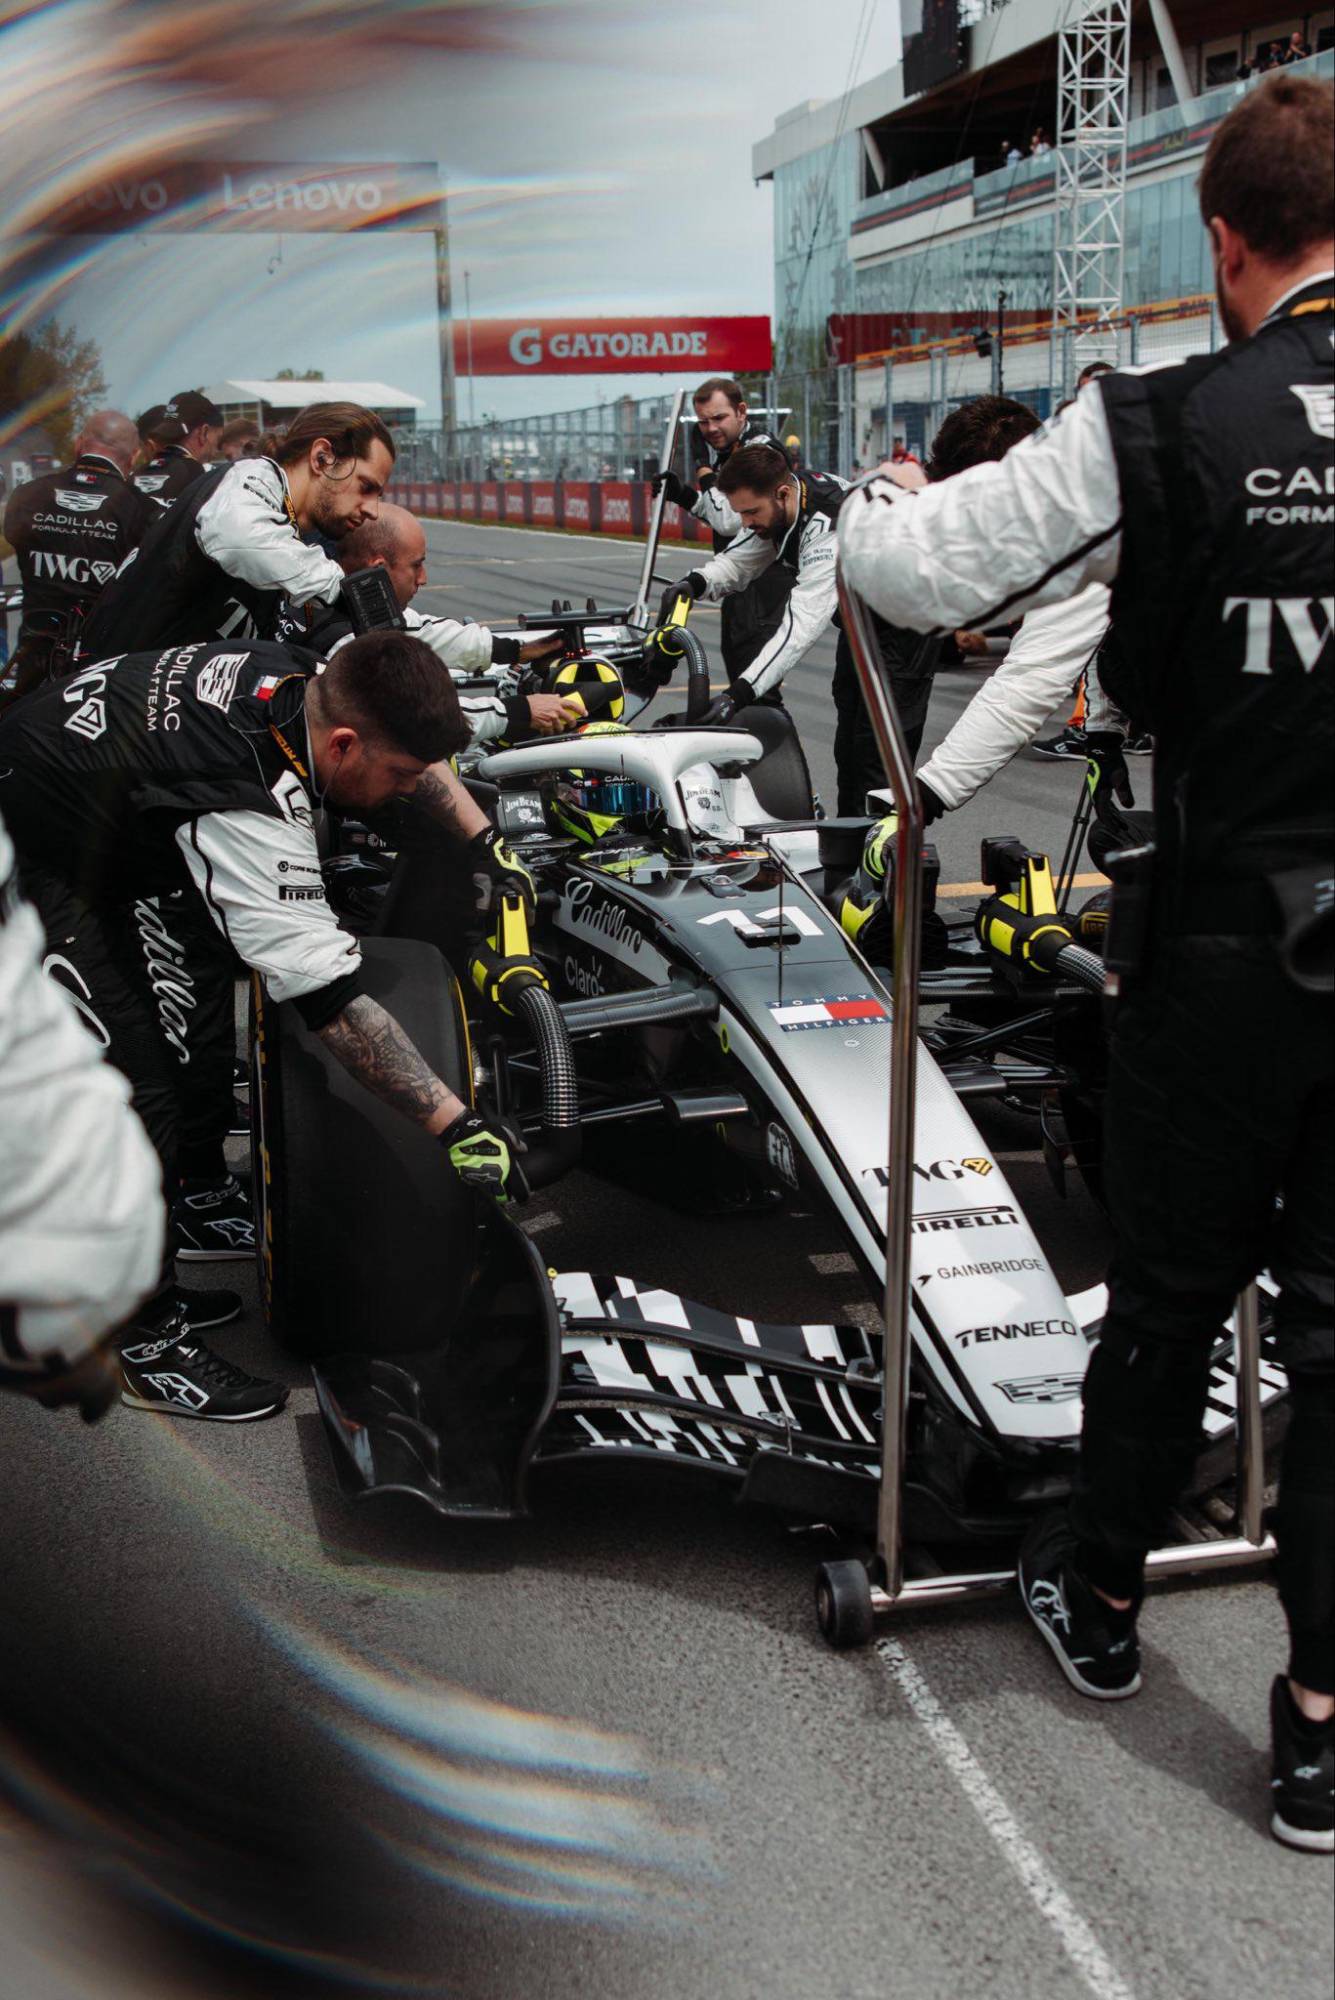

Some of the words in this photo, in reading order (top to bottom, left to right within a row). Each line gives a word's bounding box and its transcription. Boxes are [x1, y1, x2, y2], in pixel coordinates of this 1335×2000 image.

[223, 173, 382, 212] Lenovo
[549, 331, 708, 359] GATORADE
[32, 524, 78, 535] FORMULA
[88, 531, 117, 540] TEAM
[33, 512, 119, 532] CADILLAC
[30, 551, 91, 583] TWG
[146, 686, 159, 732] TEAM
[565, 877, 641, 954] Cadillac
[696, 906, 824, 936] 11
[565, 955, 603, 996] Claro
[772, 994, 869, 1008] TOMMY
[787, 1016, 891, 1031] HILFIGER
[911, 1205, 1019, 1234] IRELLI
[937, 1258, 1047, 1280] GAINBRIDGE
[955, 1319, 1077, 1349] TENNECO
